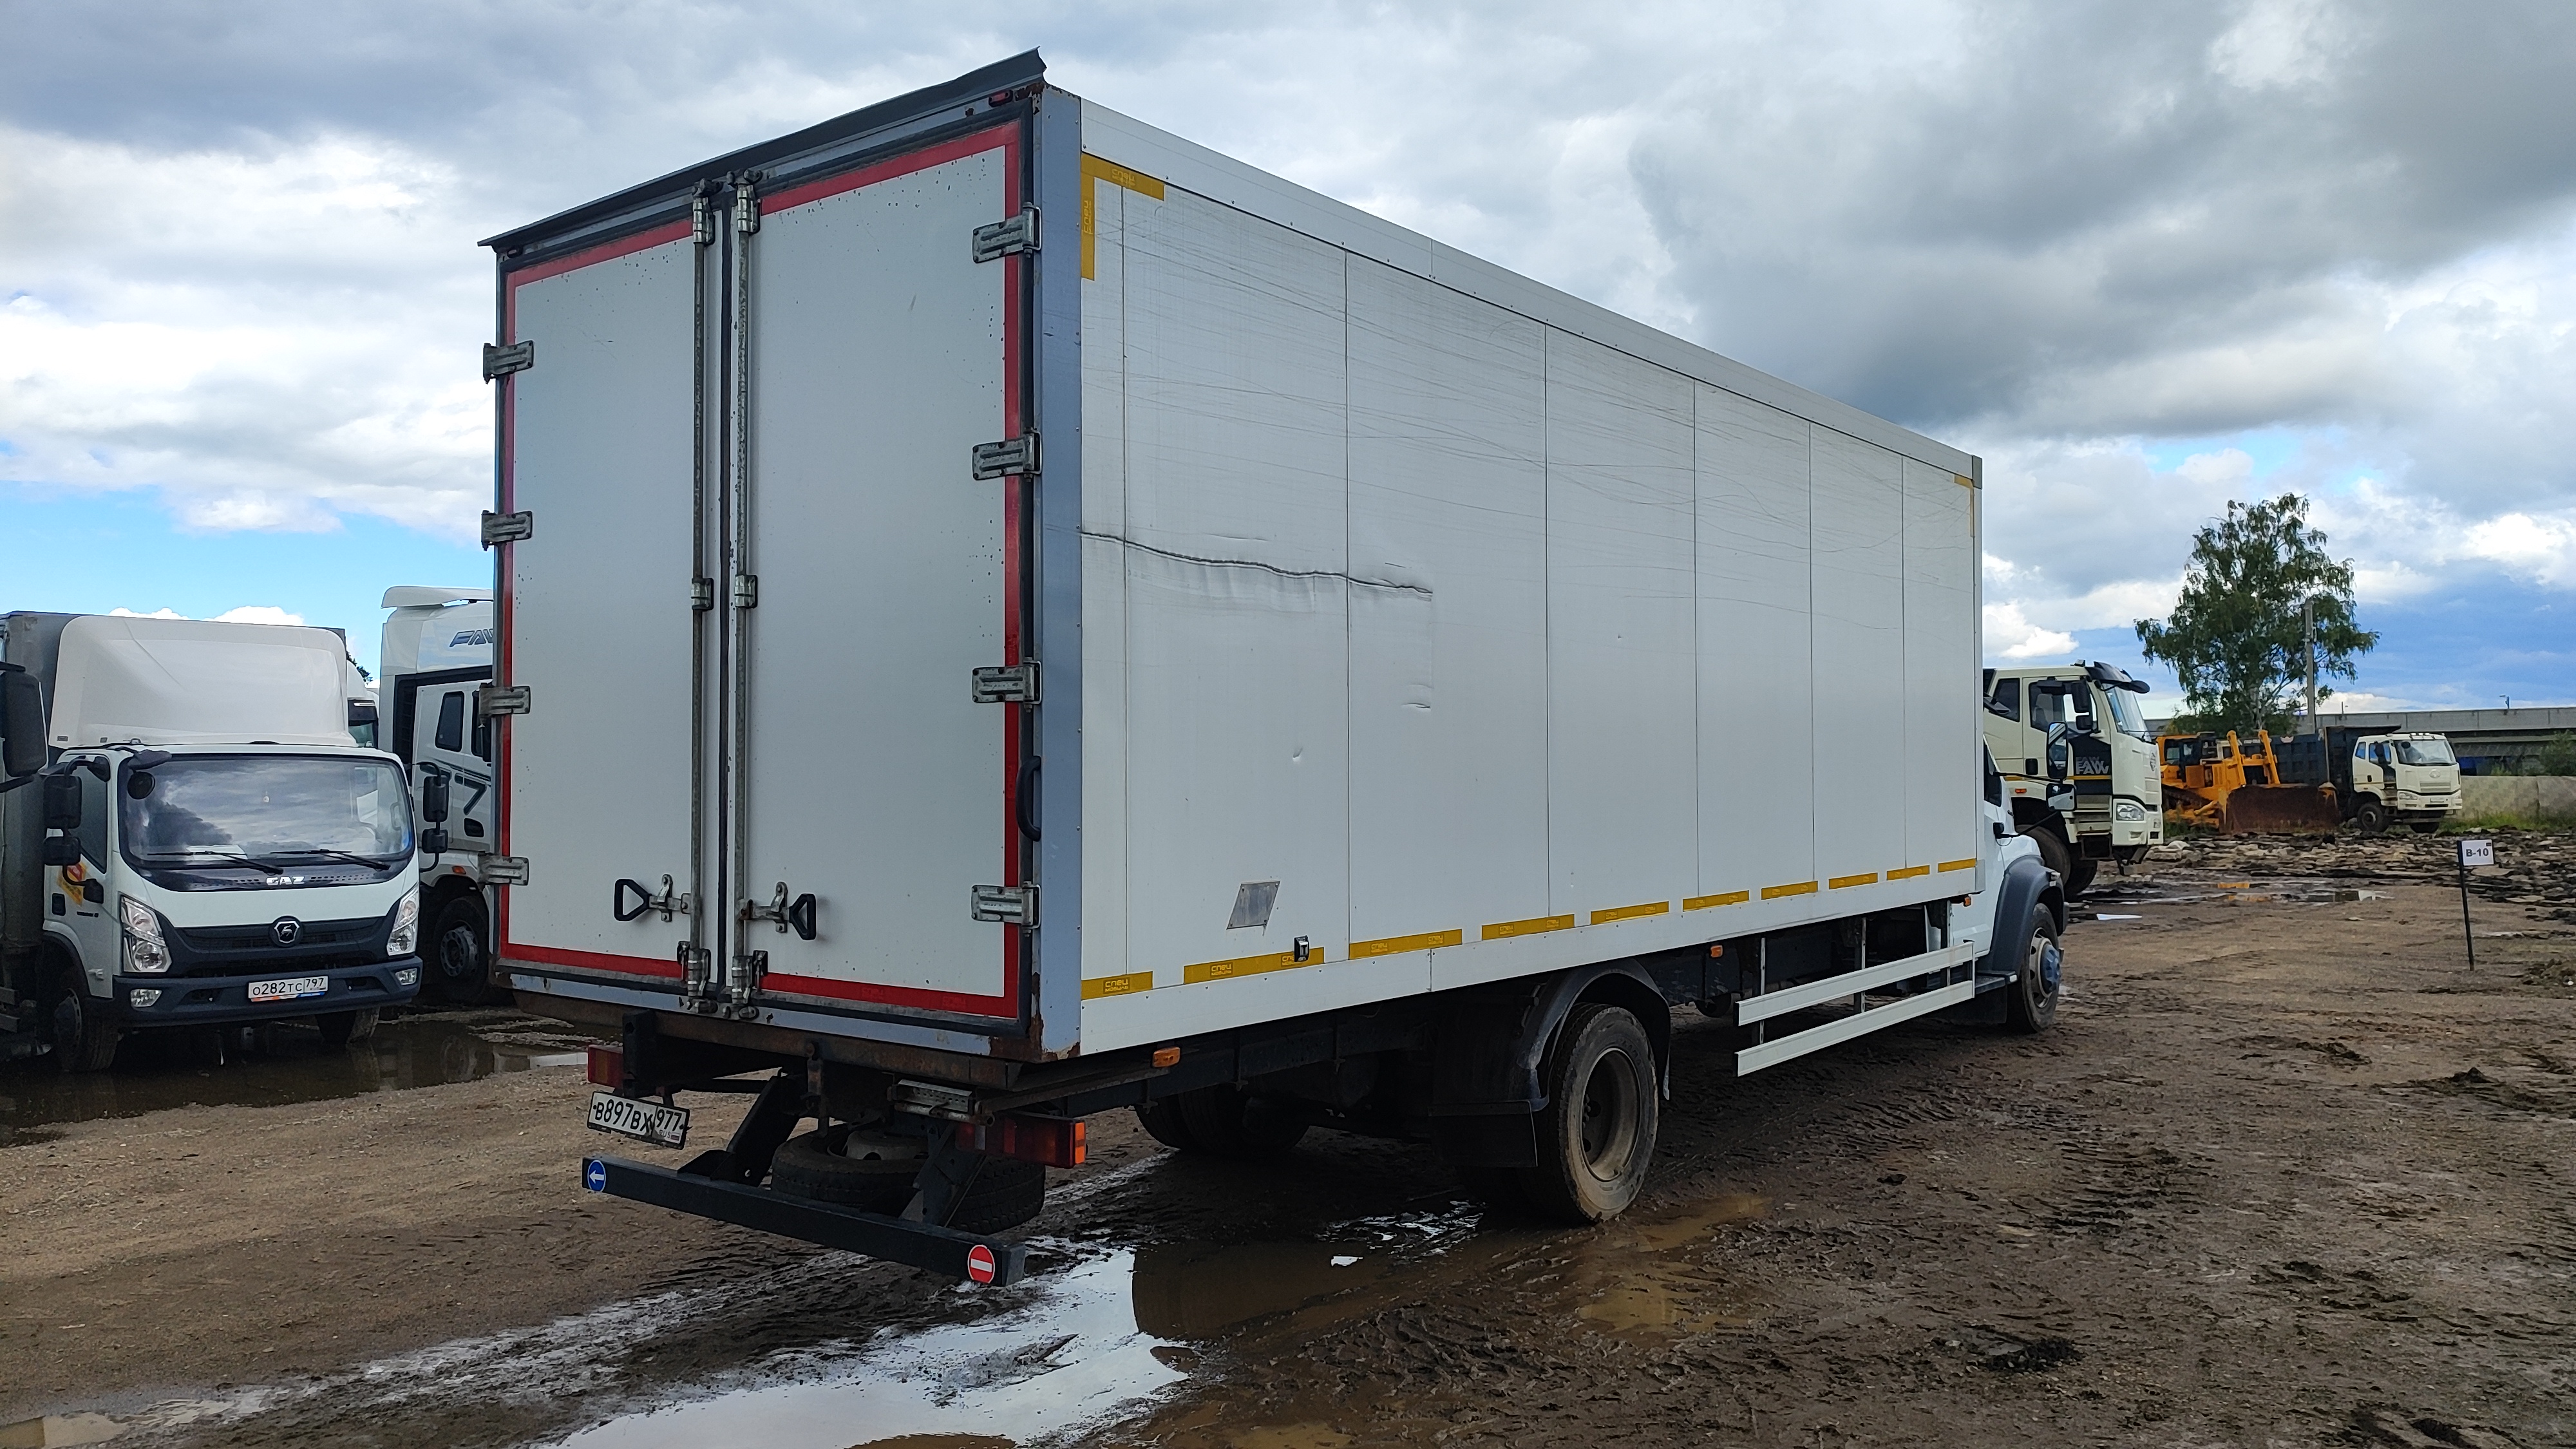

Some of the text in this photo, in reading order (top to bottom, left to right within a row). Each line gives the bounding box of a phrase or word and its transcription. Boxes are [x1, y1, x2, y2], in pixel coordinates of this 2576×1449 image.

[2076, 760, 2109, 774] FAW
[266, 876, 305, 886] GAZ
[305, 978, 324, 988] 797
[656, 1109, 682, 1132] 977
